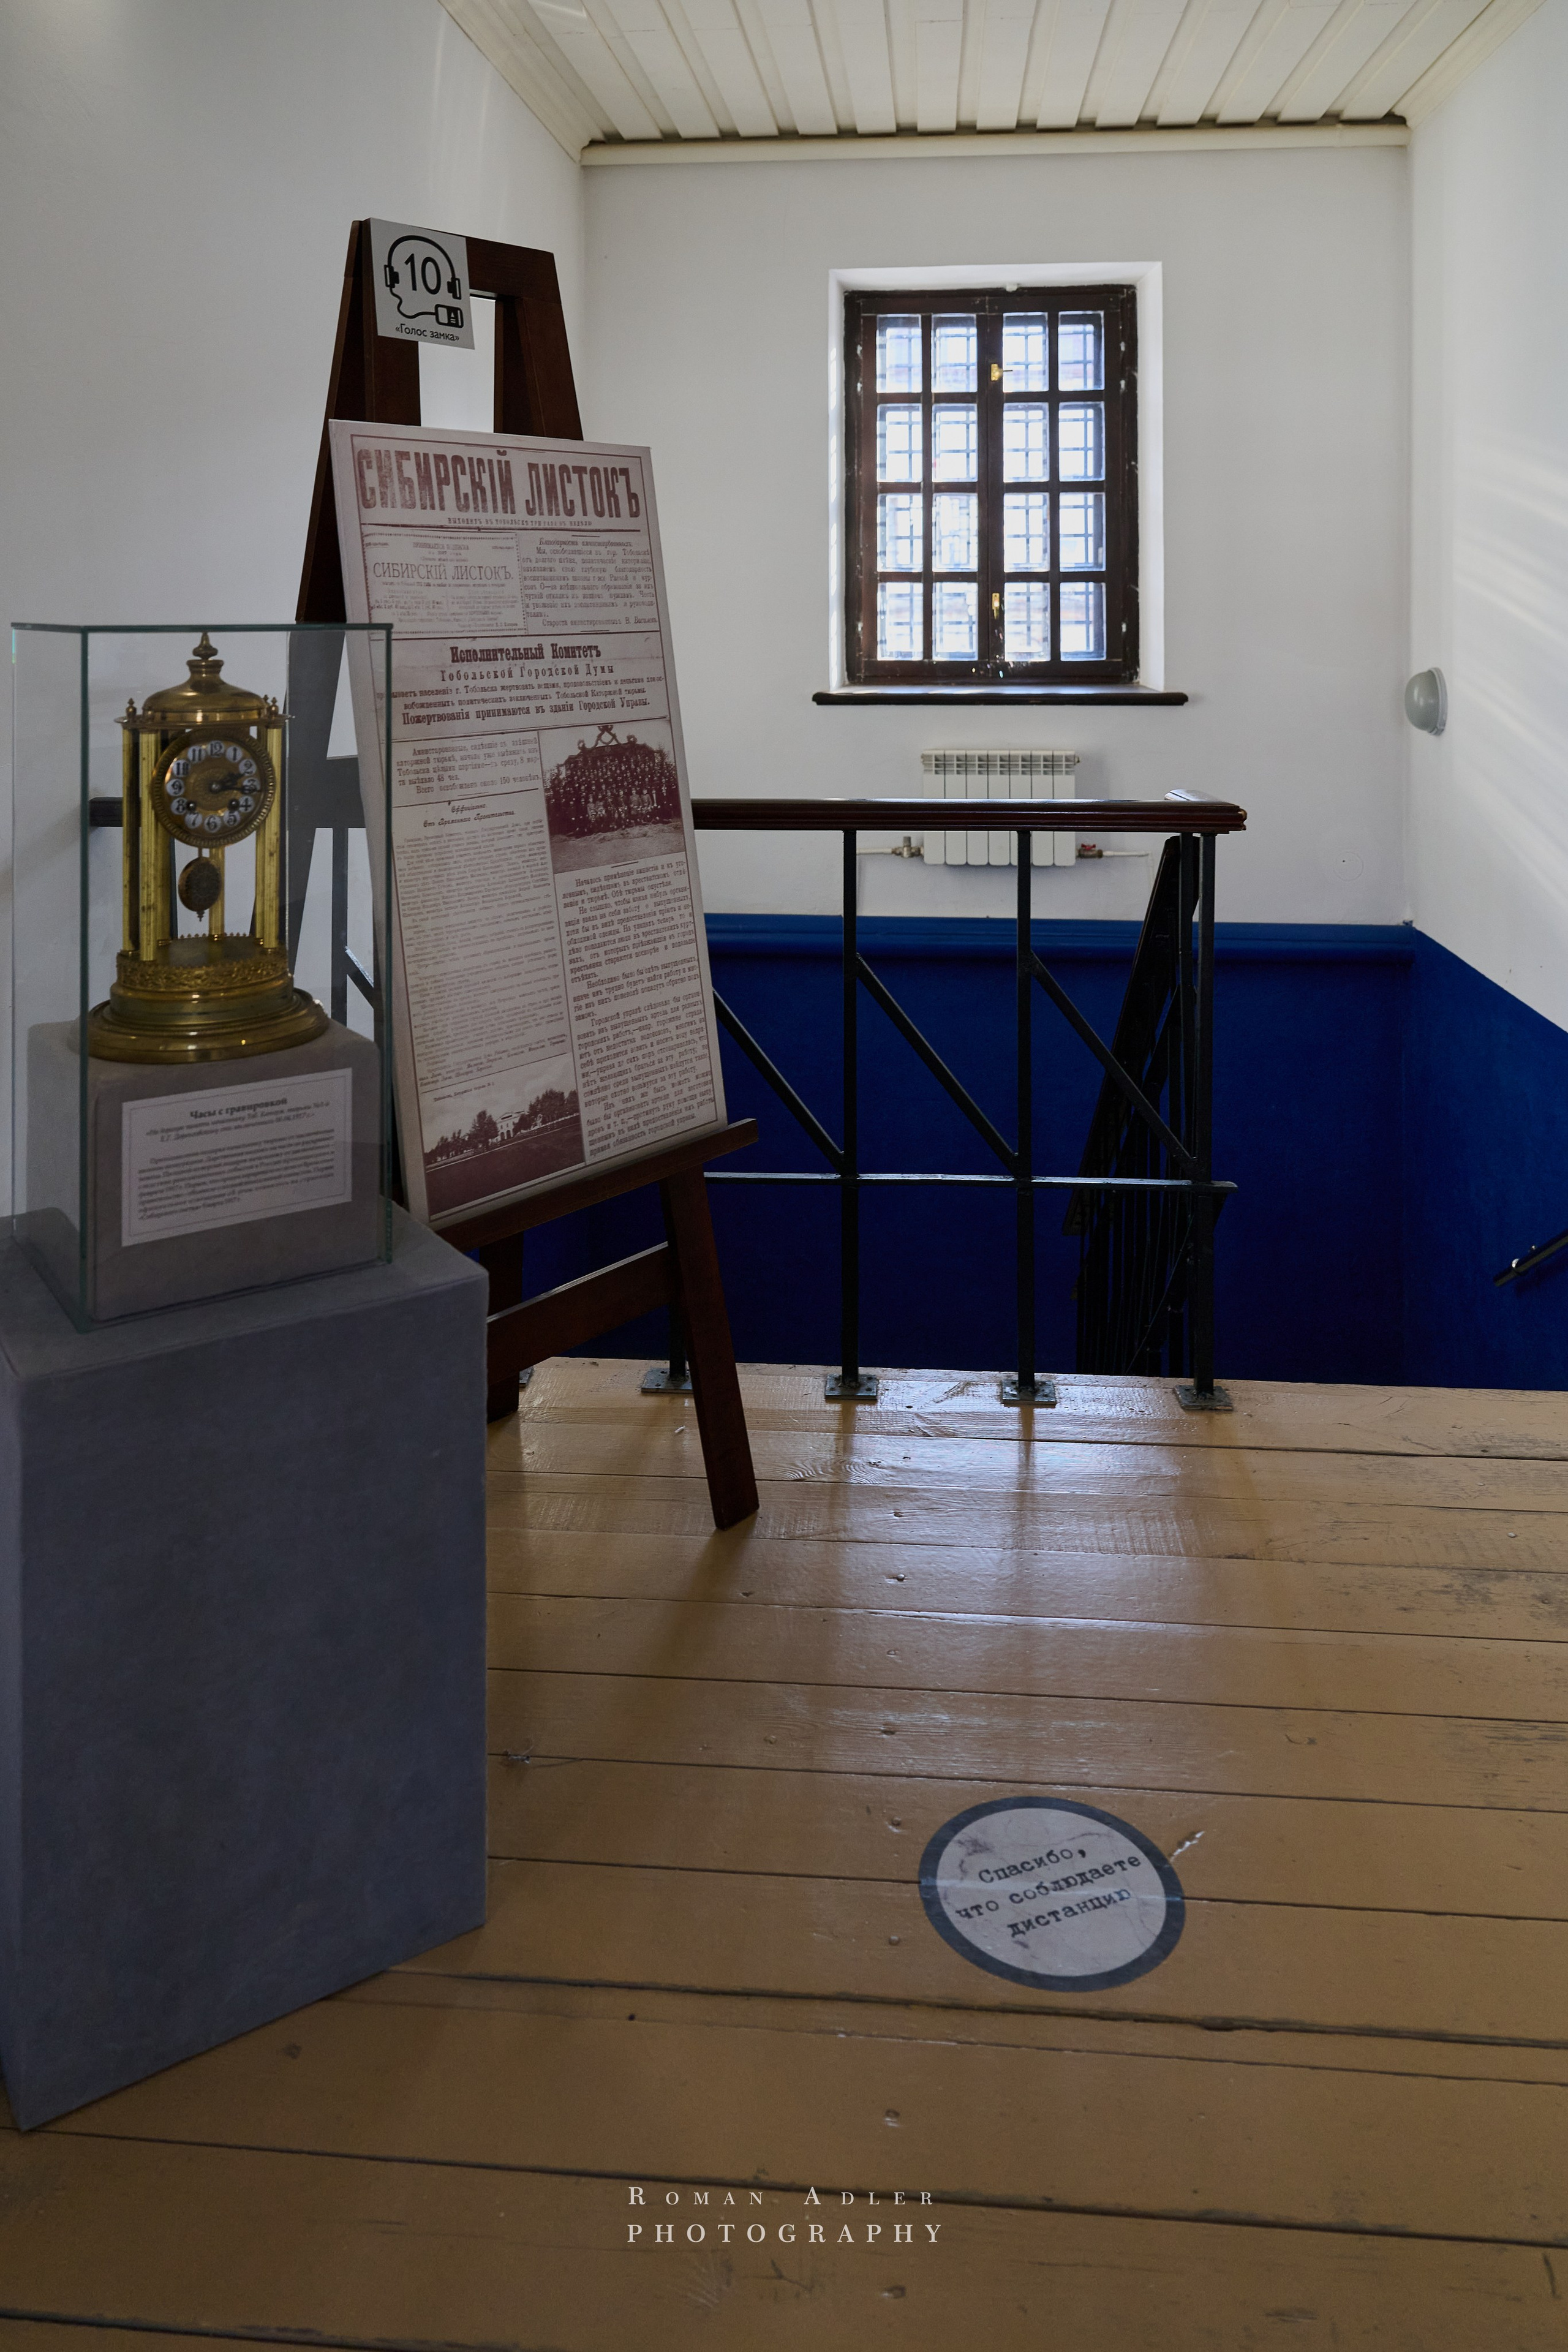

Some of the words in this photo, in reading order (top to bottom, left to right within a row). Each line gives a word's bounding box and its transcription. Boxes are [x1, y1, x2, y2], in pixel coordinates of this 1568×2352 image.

[404, 253, 442, 295] 10
[395, 323, 428, 337] «Голос
[429, 331, 460, 341] замка»
[357, 449, 516, 514] СИБИРСКІЙ
[526, 462, 640, 518] ЛИСТОКЪ
[373, 562, 447, 579] СИБИРСКІЙ
[452, 565, 513, 580] ЛИСТОКЪ.
[451, 644, 544, 663] Исполнительный
[551, 644, 601, 658] Комитетъ
[440, 667, 513, 681] Тобольской
[520, 665, 579, 679] Городской
[586, 663, 614, 676] Думы
[402, 712, 469, 725] Пожертвованія
[476, 707, 530, 720] принимаются
[549, 703, 573, 713] зданіи
[579, 699, 616, 712] Городской
[620, 697, 650, 709] Управы.
[192, 748, 202, 761] 11
[210, 742, 223, 757] 12
[176, 762, 189, 776] 10
[244, 760, 253, 774] 2
[172, 780, 182, 794] 9
[177, 799, 186, 813] 8
[239, 798, 251, 811] 4
[191, 812, 199, 826] 7
[206, 816, 217, 831] 6
[227, 813, 236, 826] 5
[190, 1110, 216, 1119] Часы
[978, 1849, 1087, 1883] Спасибо,
[956, 1901, 1000, 1920] что
[1009, 1856, 1141, 1904] соблюдаете
